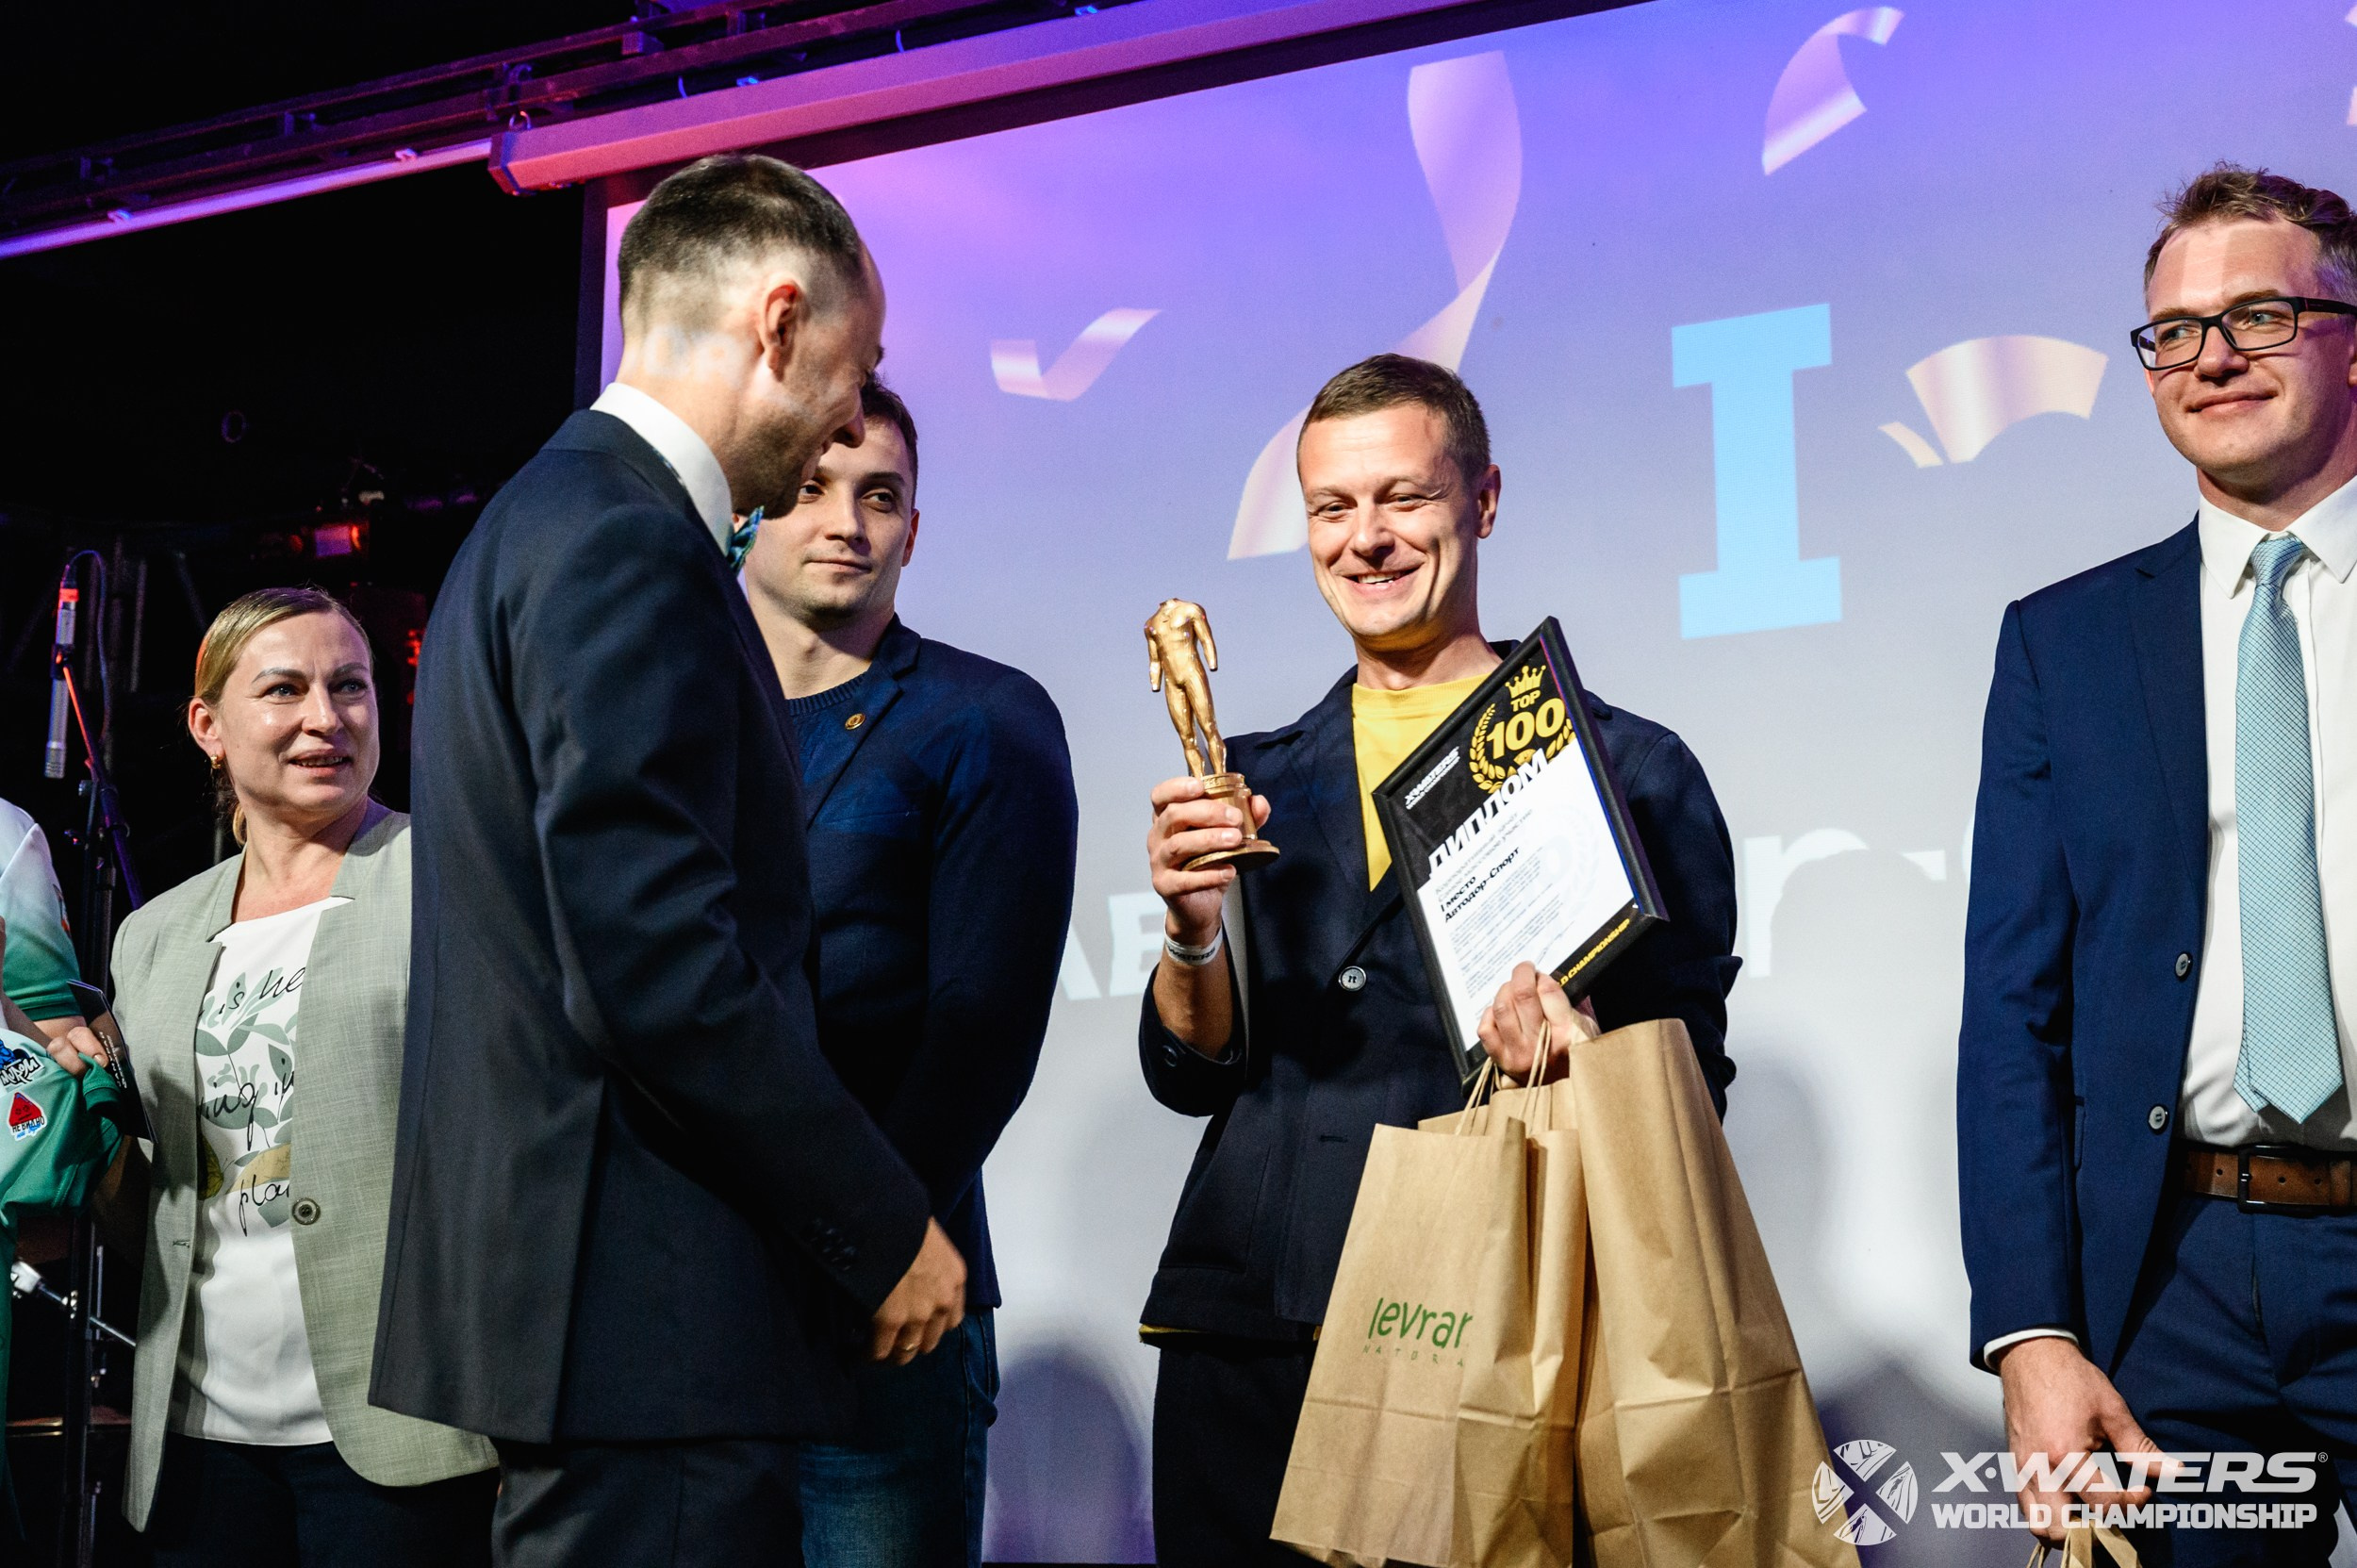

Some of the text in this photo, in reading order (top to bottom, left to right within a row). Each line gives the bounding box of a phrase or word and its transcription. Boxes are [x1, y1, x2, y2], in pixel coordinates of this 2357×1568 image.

[1510, 689, 1541, 712] TOP
[1486, 698, 1565, 759] 100
[1428, 748, 1551, 880] ДИПЛОМ
[1446, 876, 1476, 908] место
